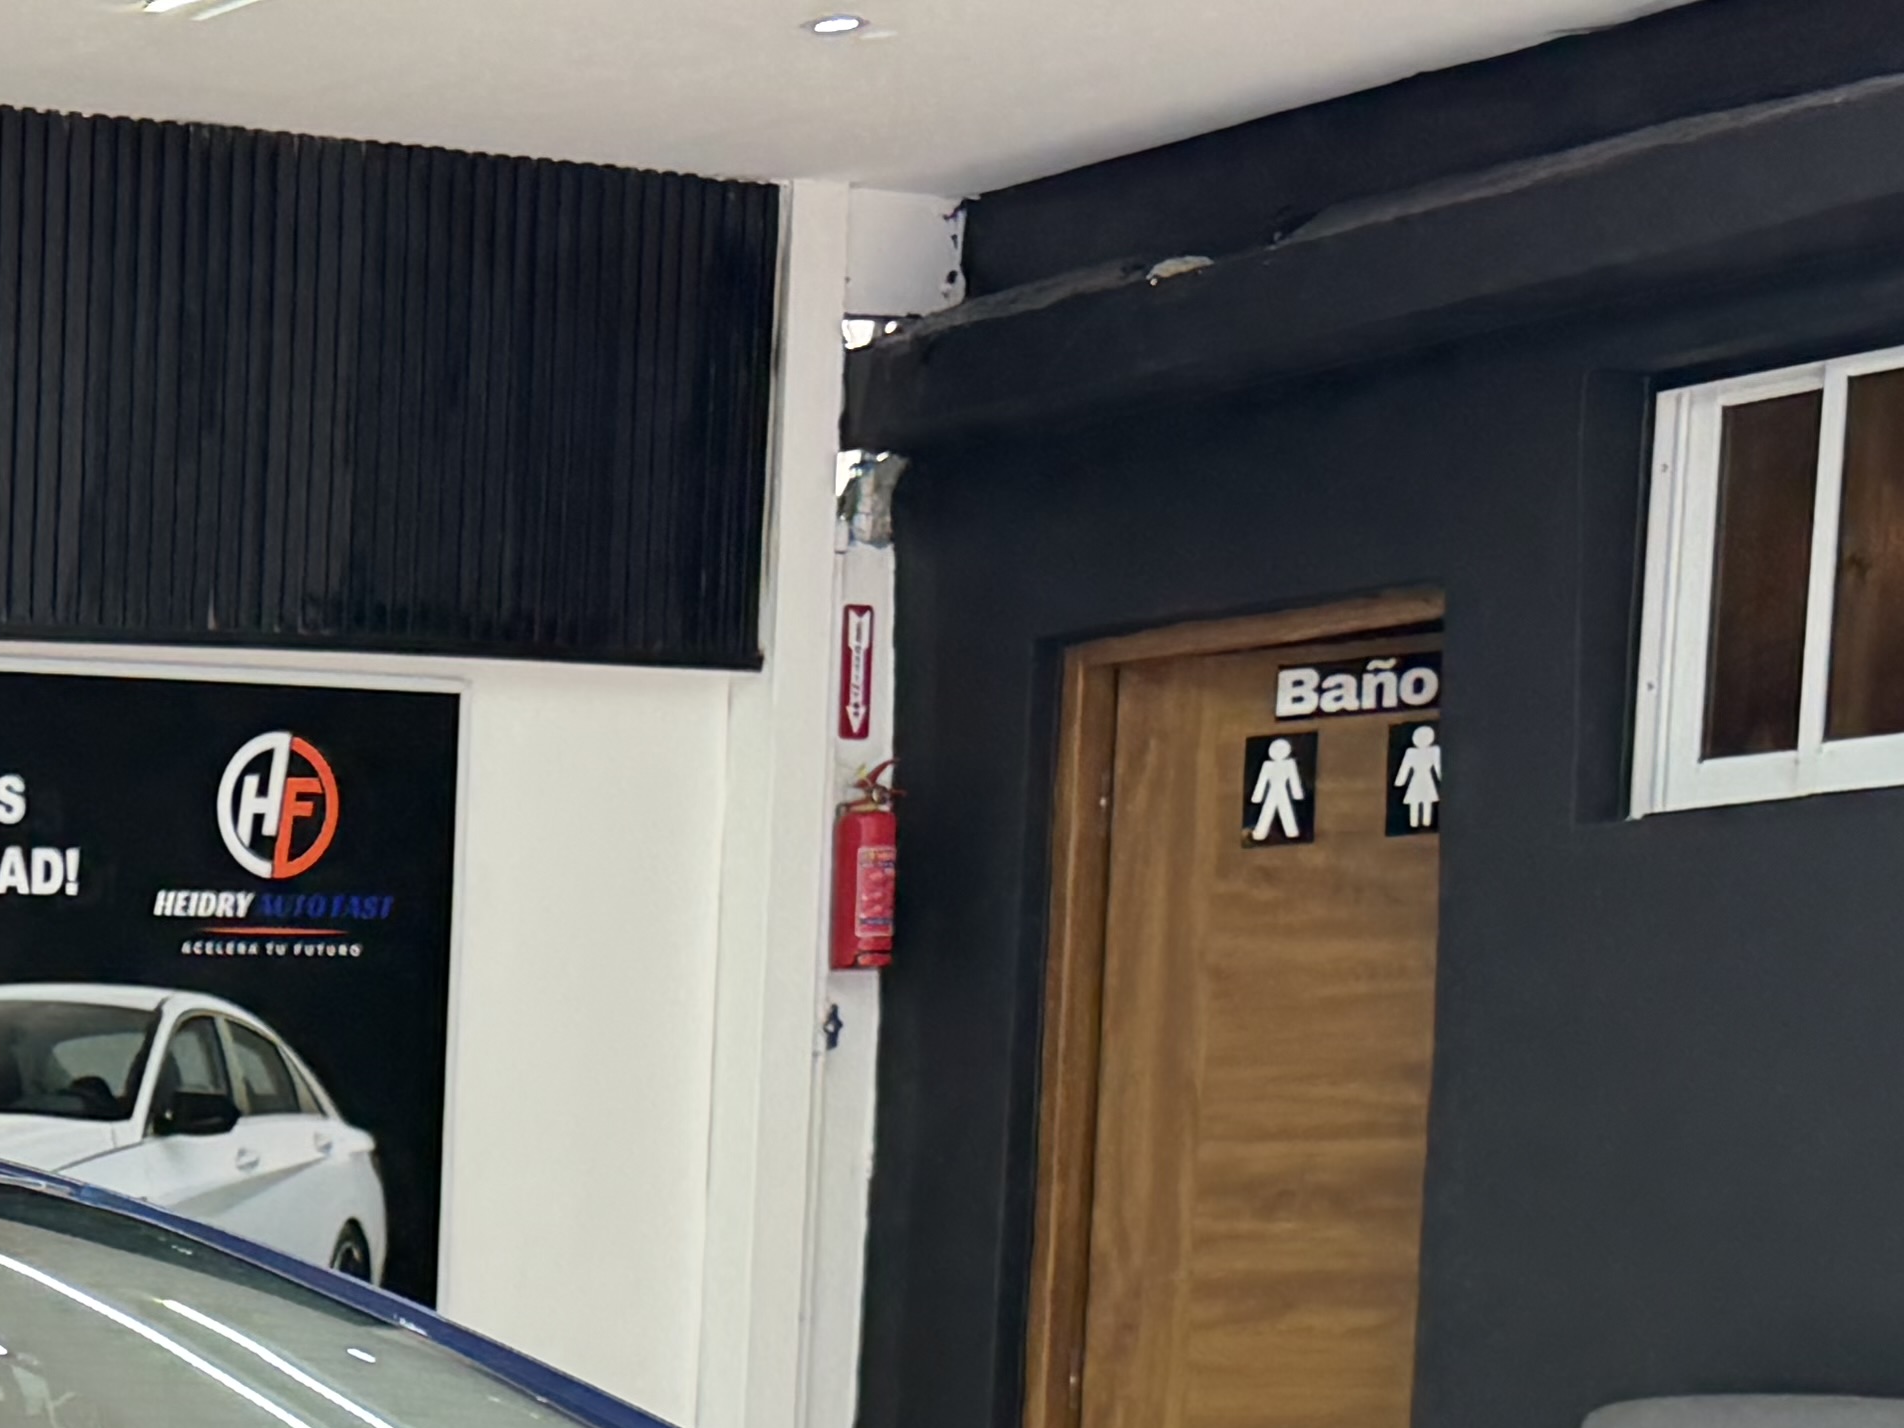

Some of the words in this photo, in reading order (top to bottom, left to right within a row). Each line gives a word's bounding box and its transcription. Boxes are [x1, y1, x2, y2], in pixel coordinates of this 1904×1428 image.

[1275, 658, 1439, 718] Baño
[153, 888, 256, 918] HEIDRY
[265, 941, 288, 956] TU
